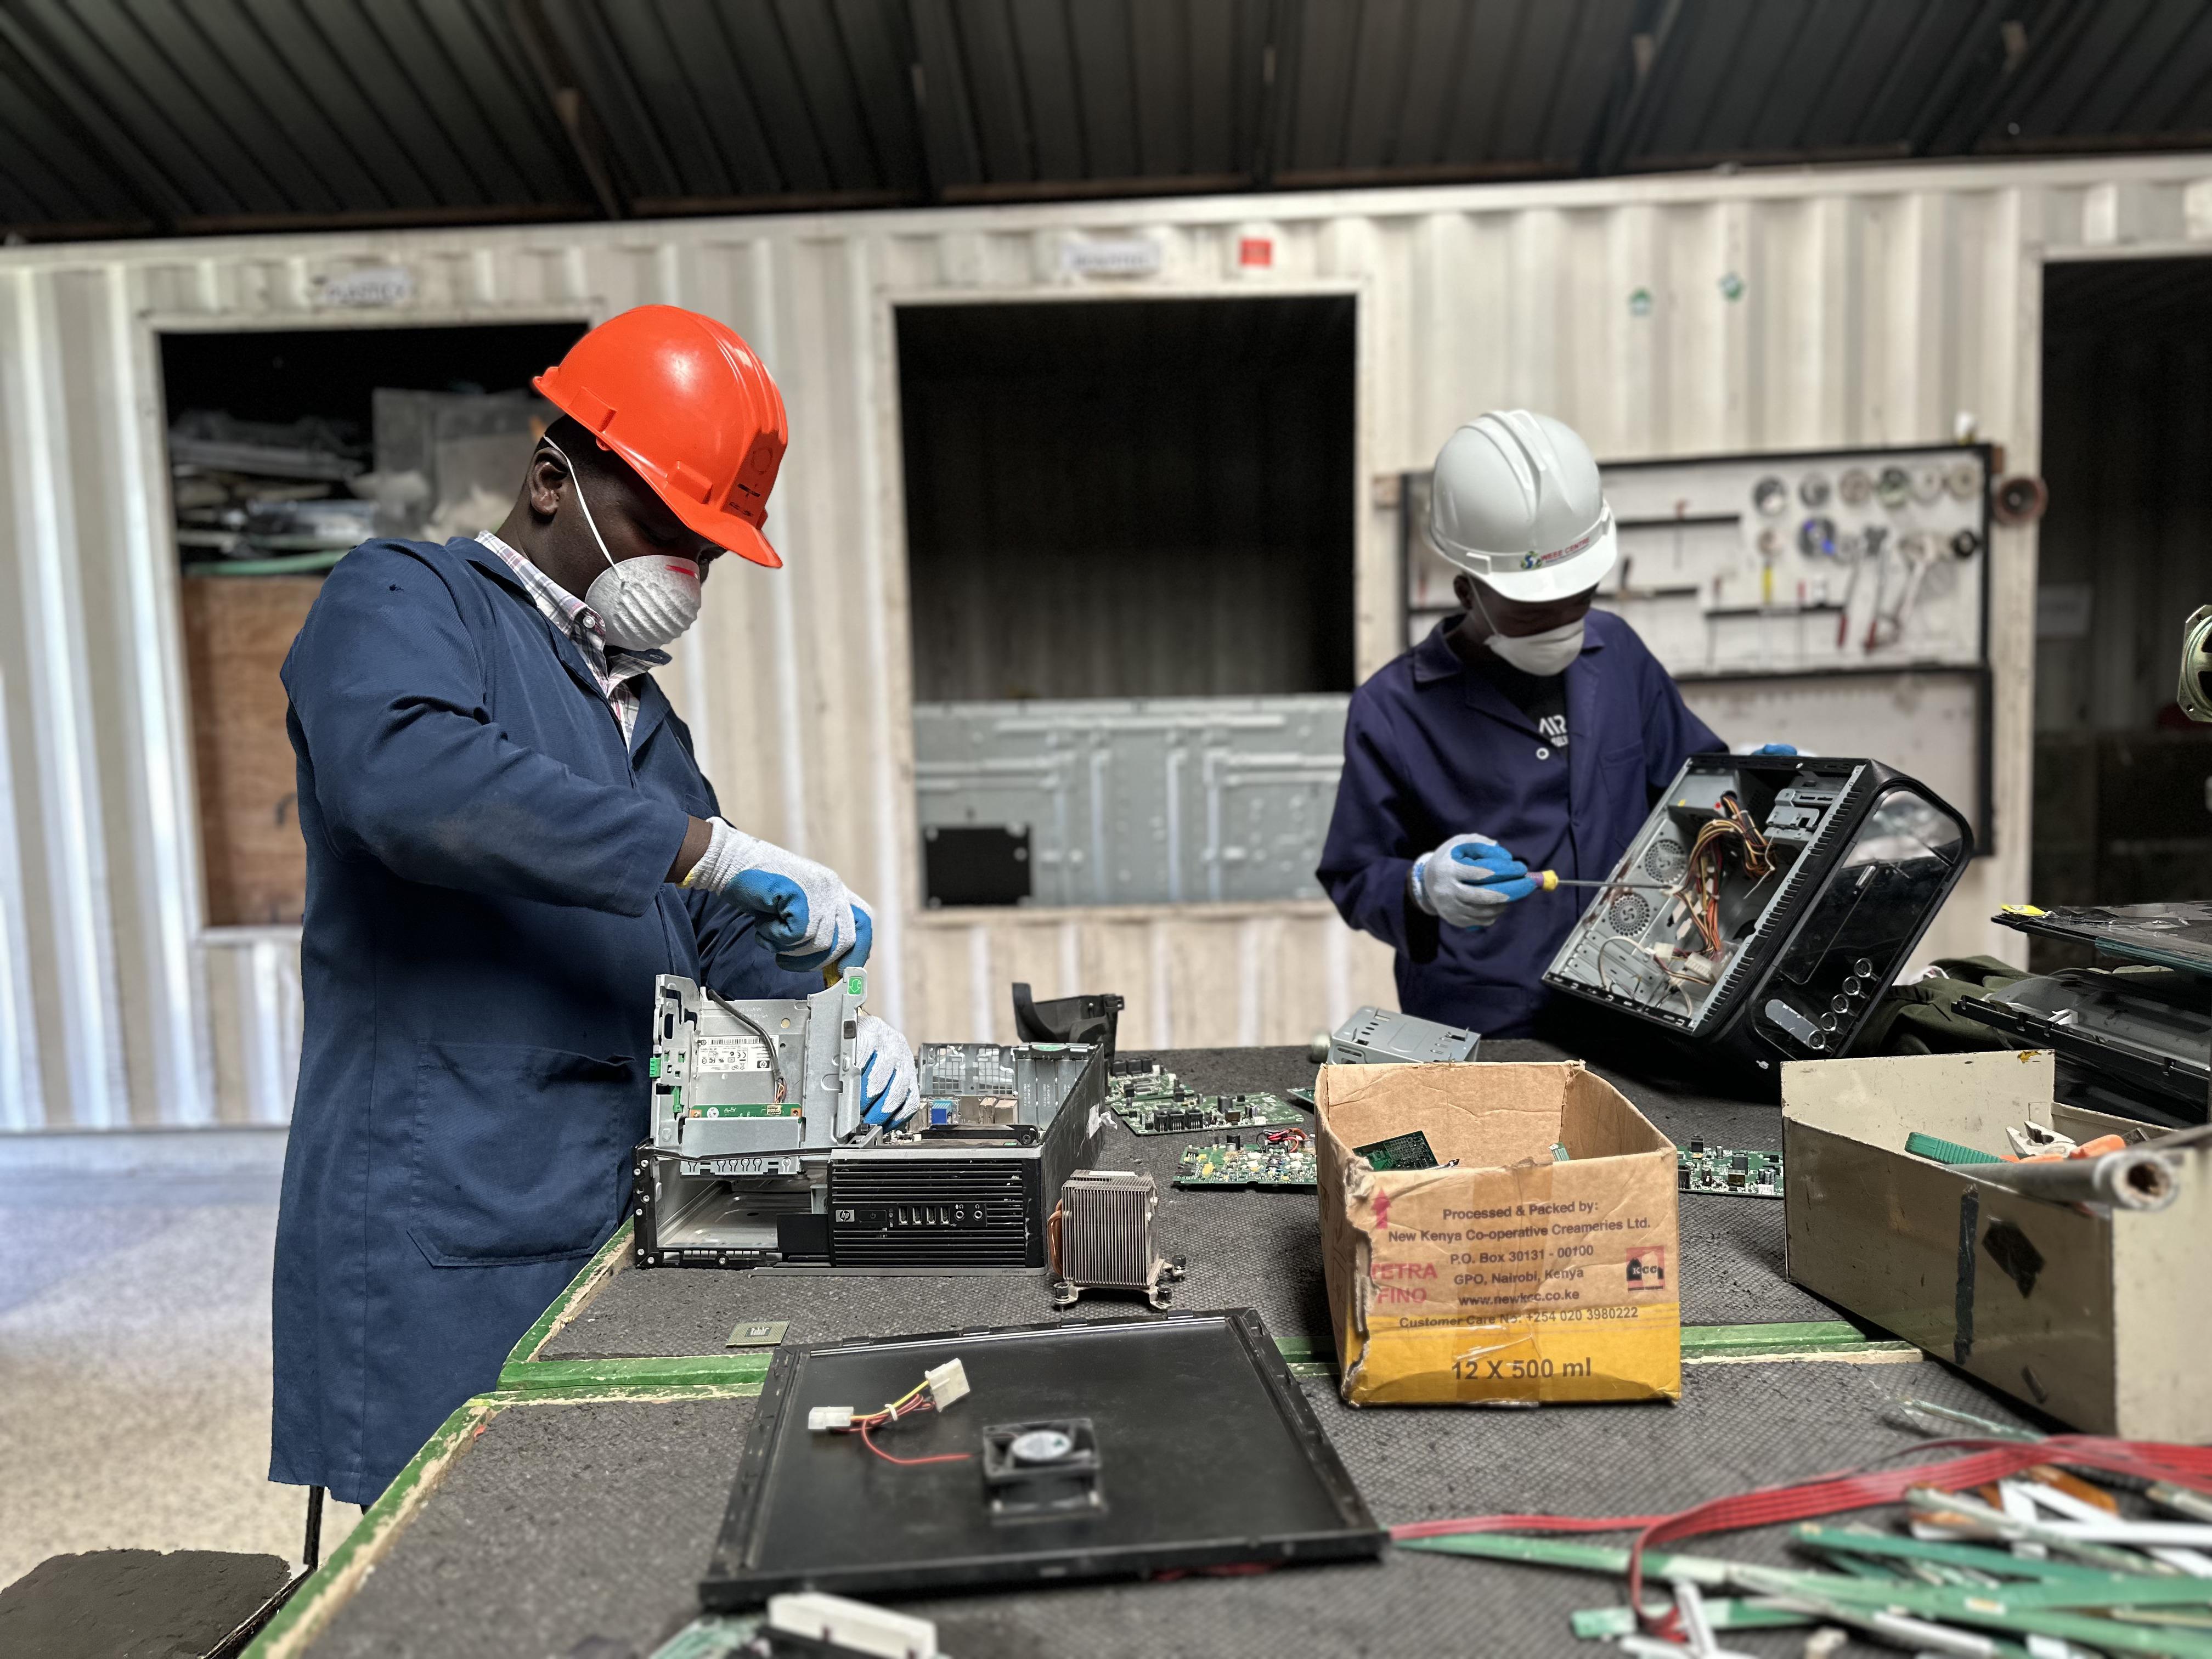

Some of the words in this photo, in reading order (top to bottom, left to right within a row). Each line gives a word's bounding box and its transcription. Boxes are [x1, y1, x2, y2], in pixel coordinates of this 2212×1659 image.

[1541, 549, 1563, 561] WEEE
[1565, 536, 1589, 554] CENTRE
[1443, 1206, 1511, 1220] Processed
[1516, 1205, 1525, 1216] &
[1529, 1201, 1575, 1215] Packed
[1579, 1200, 1598, 1214] by:
[1389, 1231, 1416, 1242] New
[1420, 1229, 1462, 1244] Kenya
[1466, 1226, 1548, 1242] Co-operative
[1552, 1219, 1623, 1235] Creameries
[1627, 1217, 1650, 1229] Ltd.
[1451, 1253, 1475, 1265] P.O.
[1480, 1252, 1505, 1263] Box
[1509, 1249, 1544, 1262] 30131
[1558, 1245, 1594, 1258] 00100
[1371, 1263, 1438, 1279] TETRA
[1454, 1273, 1487, 1285] GPO,
[1492, 1271, 1541, 1284] Nairobi,
[1544, 1268, 1584, 1280] Kenya
[1632, 1265, 1657, 1274] KCC
[1378, 1287, 1427, 1304] FINO
[1458, 1289, 1580, 1306] www.newkcc.co.ke
[1400, 1316, 1462, 1328] Customer
[1466, 1314, 1496, 1325] Care
[1526, 1310, 1556, 1323] +254
[1560, 1310, 1582, 1322] 020
[1587, 1306, 1639, 1321] 3980222
[1452, 1361, 1479, 1380] 12
[1486, 1359, 1504, 1379] X
[1512, 1358, 1554, 1379] 500
[1562, 1357, 1591, 1377] ml
